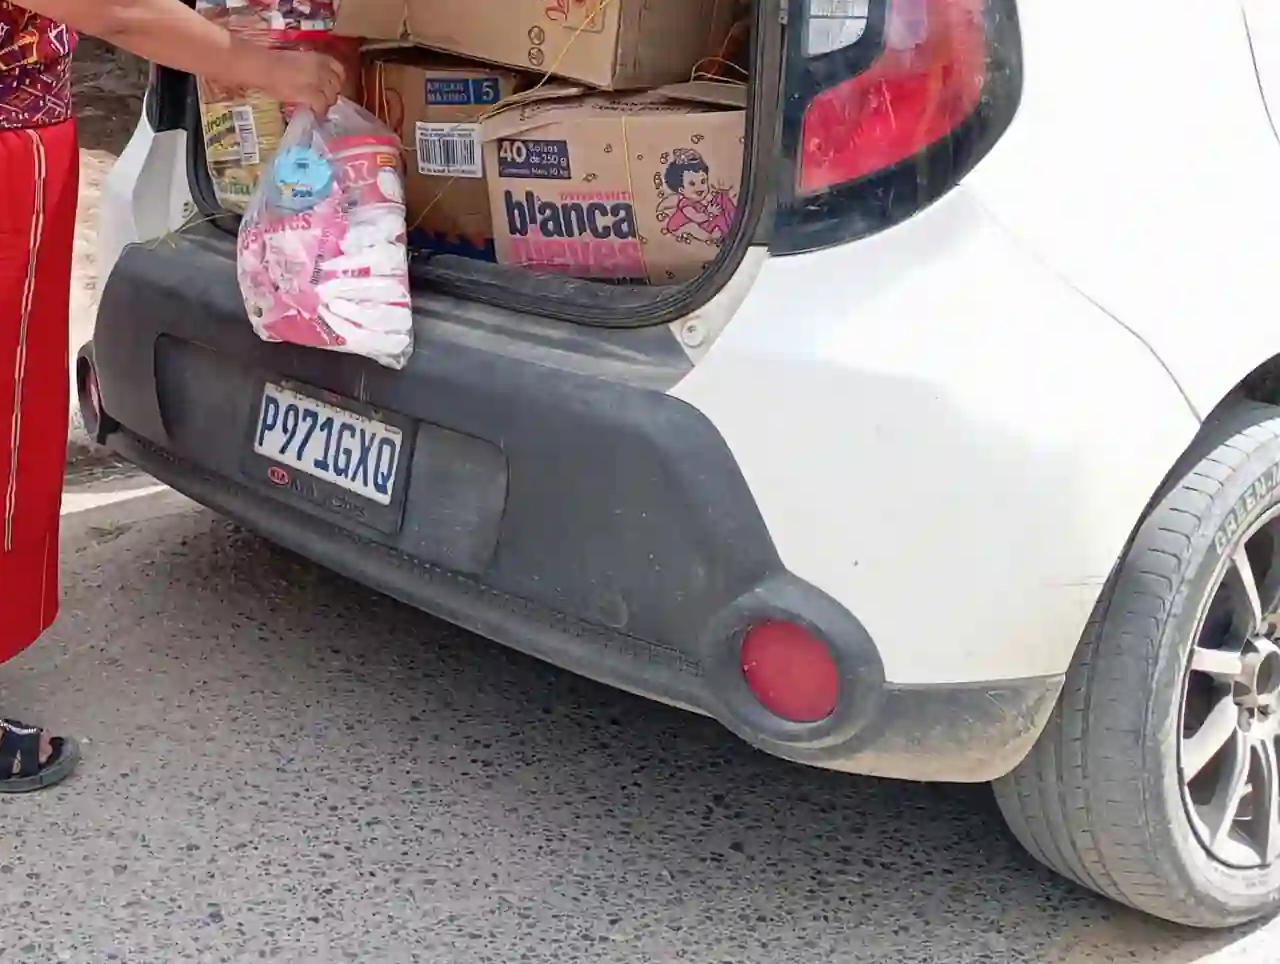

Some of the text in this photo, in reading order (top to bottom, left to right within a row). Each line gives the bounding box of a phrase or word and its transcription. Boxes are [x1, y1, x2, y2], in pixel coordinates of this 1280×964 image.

[482, 82, 495, 101] 5
[500, 140, 527, 164] 40
[504, 189, 638, 239] blanca
[258, 394, 397, 495] P971GXQ
